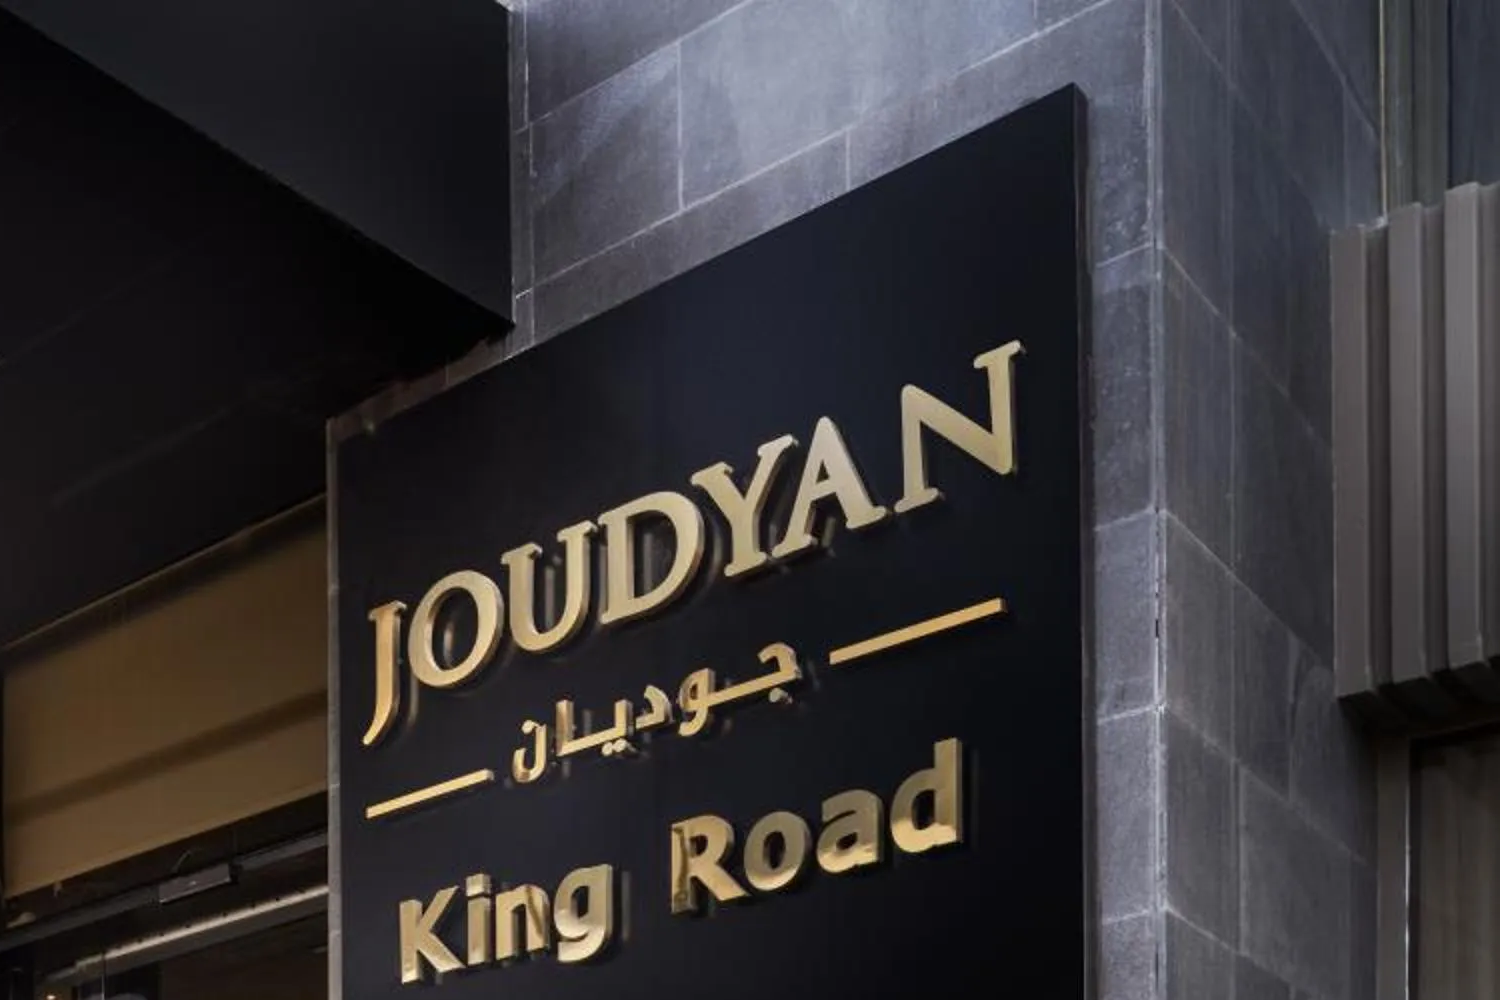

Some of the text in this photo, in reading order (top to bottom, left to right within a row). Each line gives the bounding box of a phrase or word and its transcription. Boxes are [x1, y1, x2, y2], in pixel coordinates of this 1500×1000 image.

[362, 339, 1025, 747] JOUDYAN
[512, 642, 802, 783] جوديان
[398, 738, 962, 985] King Road
